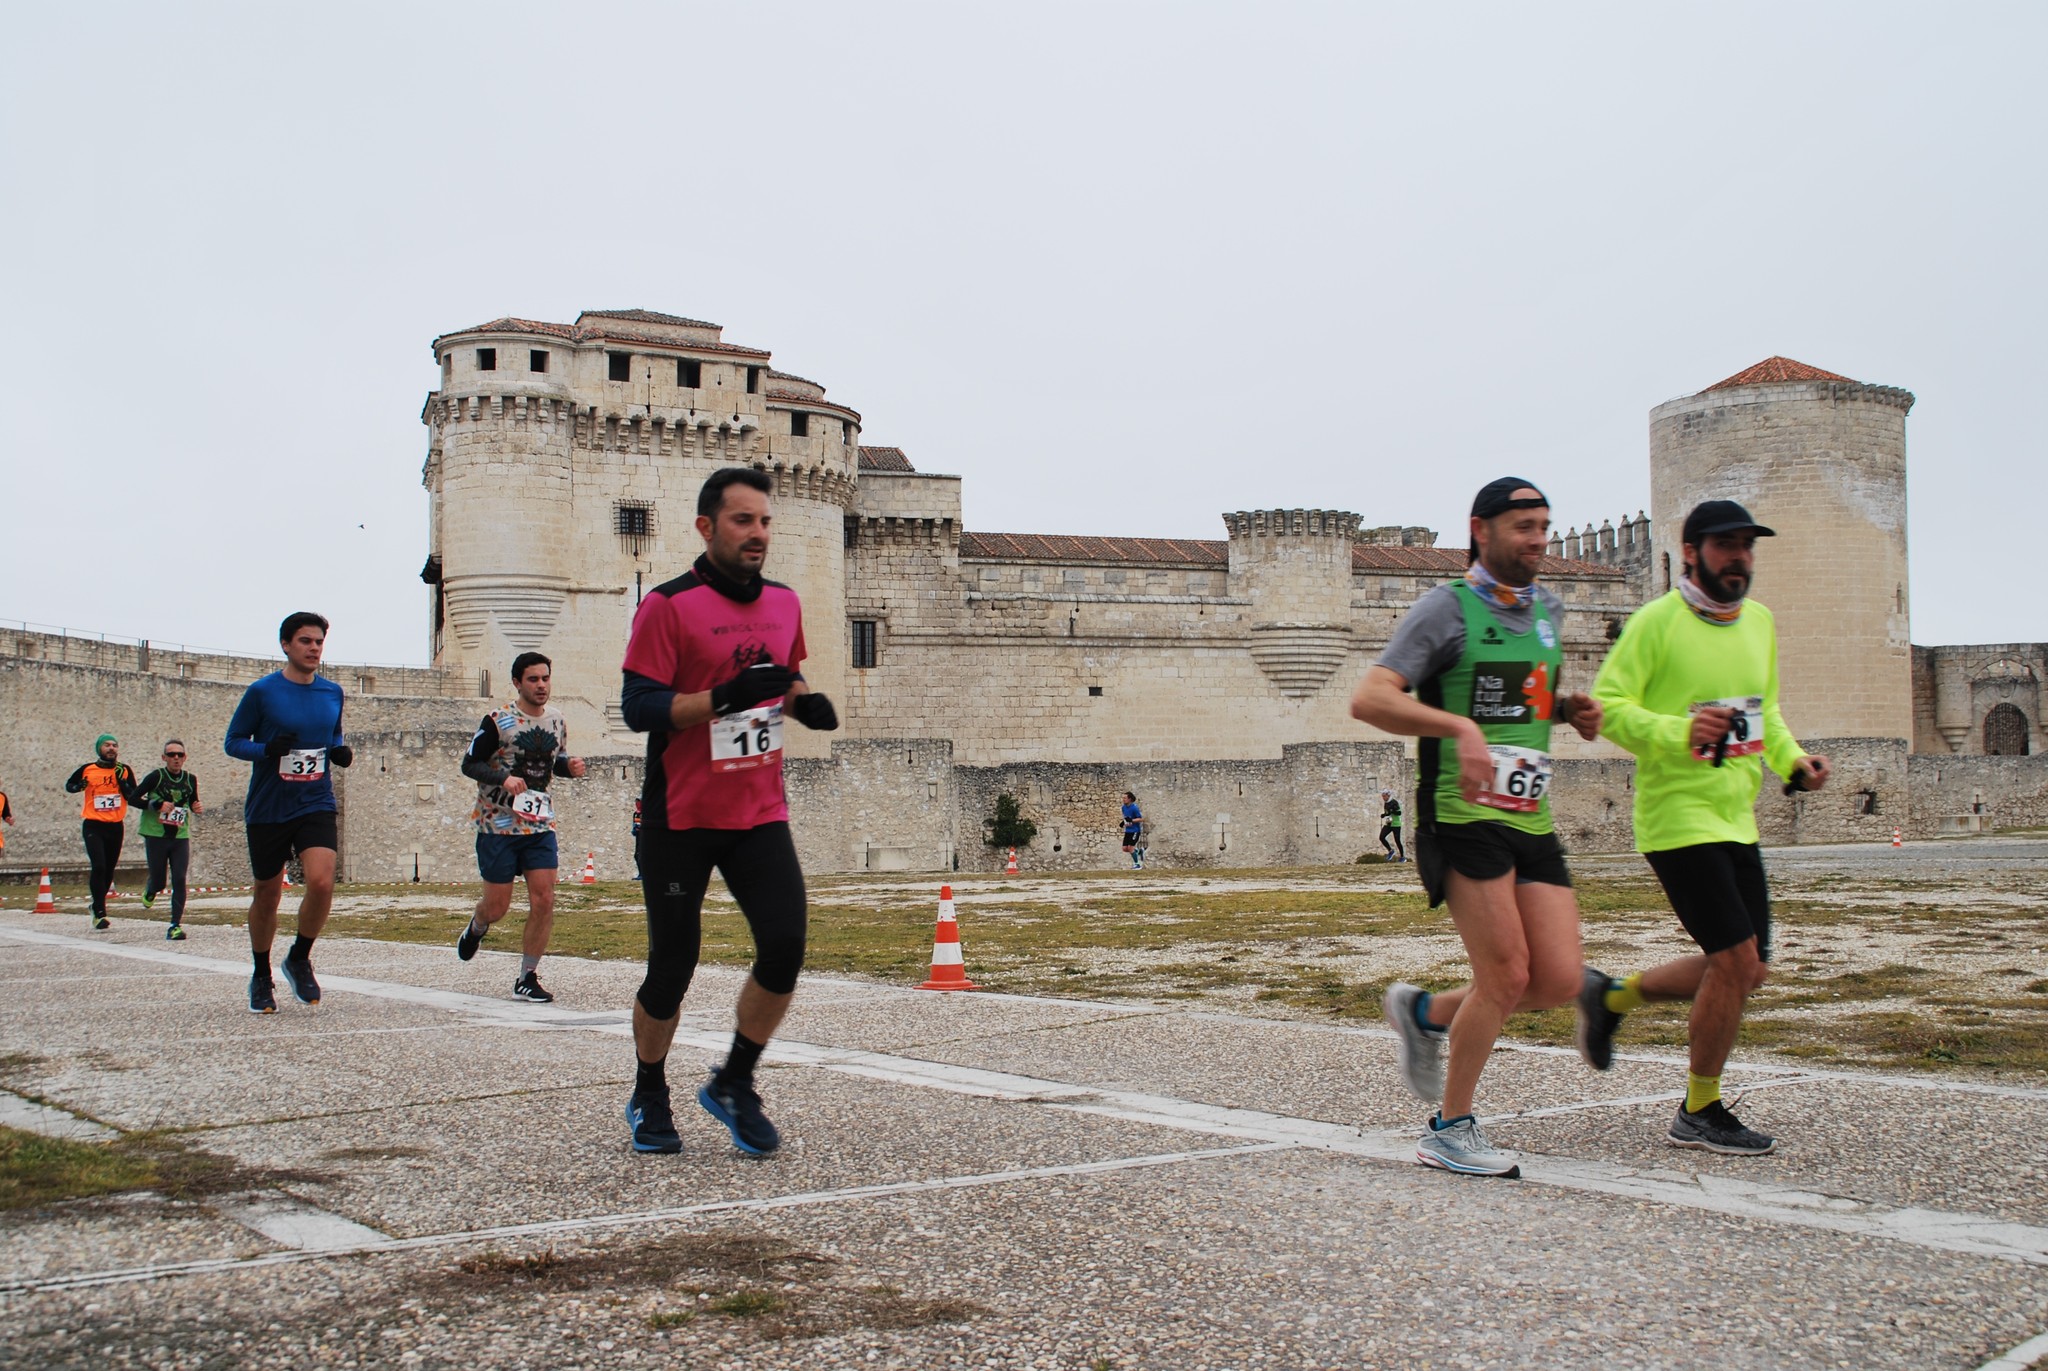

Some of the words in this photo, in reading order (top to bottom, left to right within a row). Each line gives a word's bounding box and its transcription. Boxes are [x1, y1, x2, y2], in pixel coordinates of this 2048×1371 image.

[1476, 675, 1504, 689] Na
[732, 728, 770, 756] 16
[292, 761, 317, 774] 32
[1492, 767, 1545, 798] 66
[100, 797, 116, 808] 14
[523, 800, 542, 816] 31
[163, 812, 184, 821] 136
